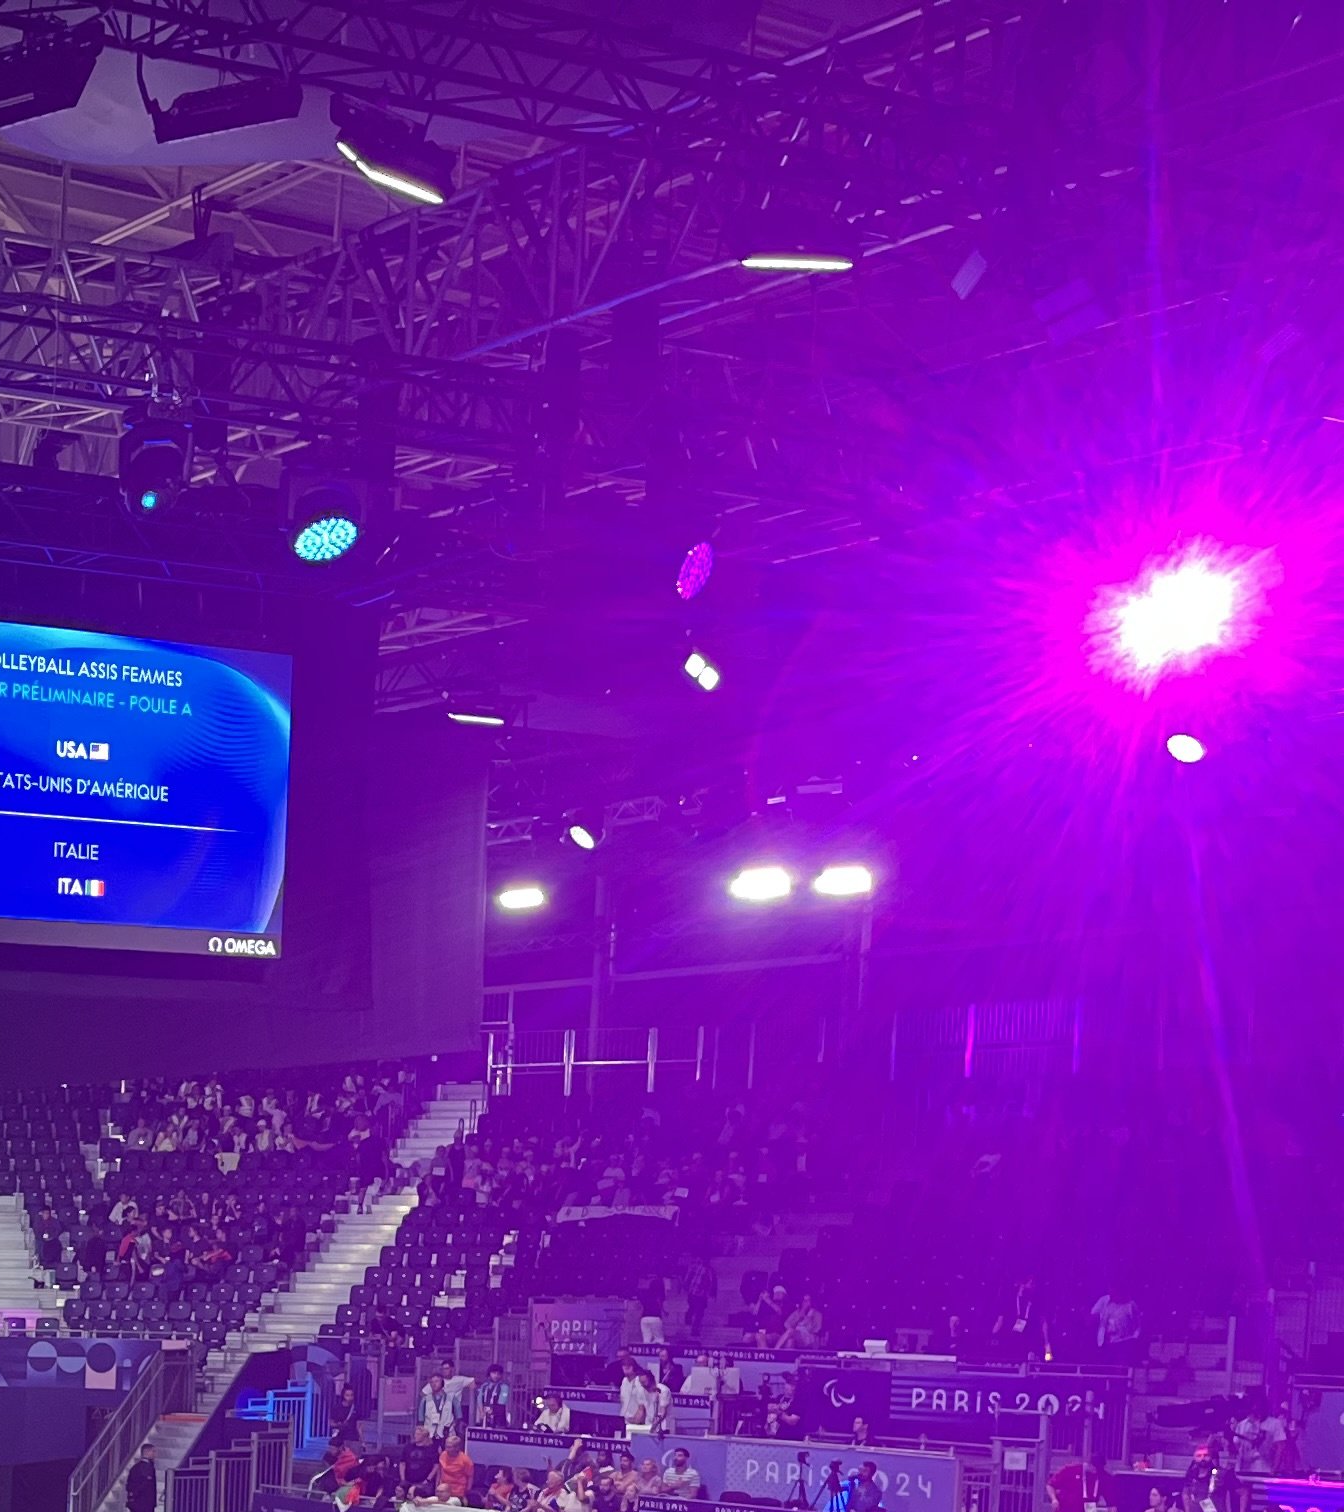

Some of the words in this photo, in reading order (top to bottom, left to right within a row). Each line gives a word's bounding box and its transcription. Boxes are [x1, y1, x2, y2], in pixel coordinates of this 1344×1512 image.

[79, 661, 118, 680] ASSIS
[122, 667, 184, 687] FEMMES
[12, 680, 115, 709] PRÉLIMINAIRE
[129, 694, 178, 715] POULE
[181, 701, 193, 717] A
[56, 740, 88, 759] USA
[76, 776, 170, 803] D'AMÉRIQUE
[53, 841, 100, 861] ITALIE
[57, 877, 83, 897] ITA
[225, 938, 276, 955] OMEGA
[911, 1387, 1001, 1414] PARIS
